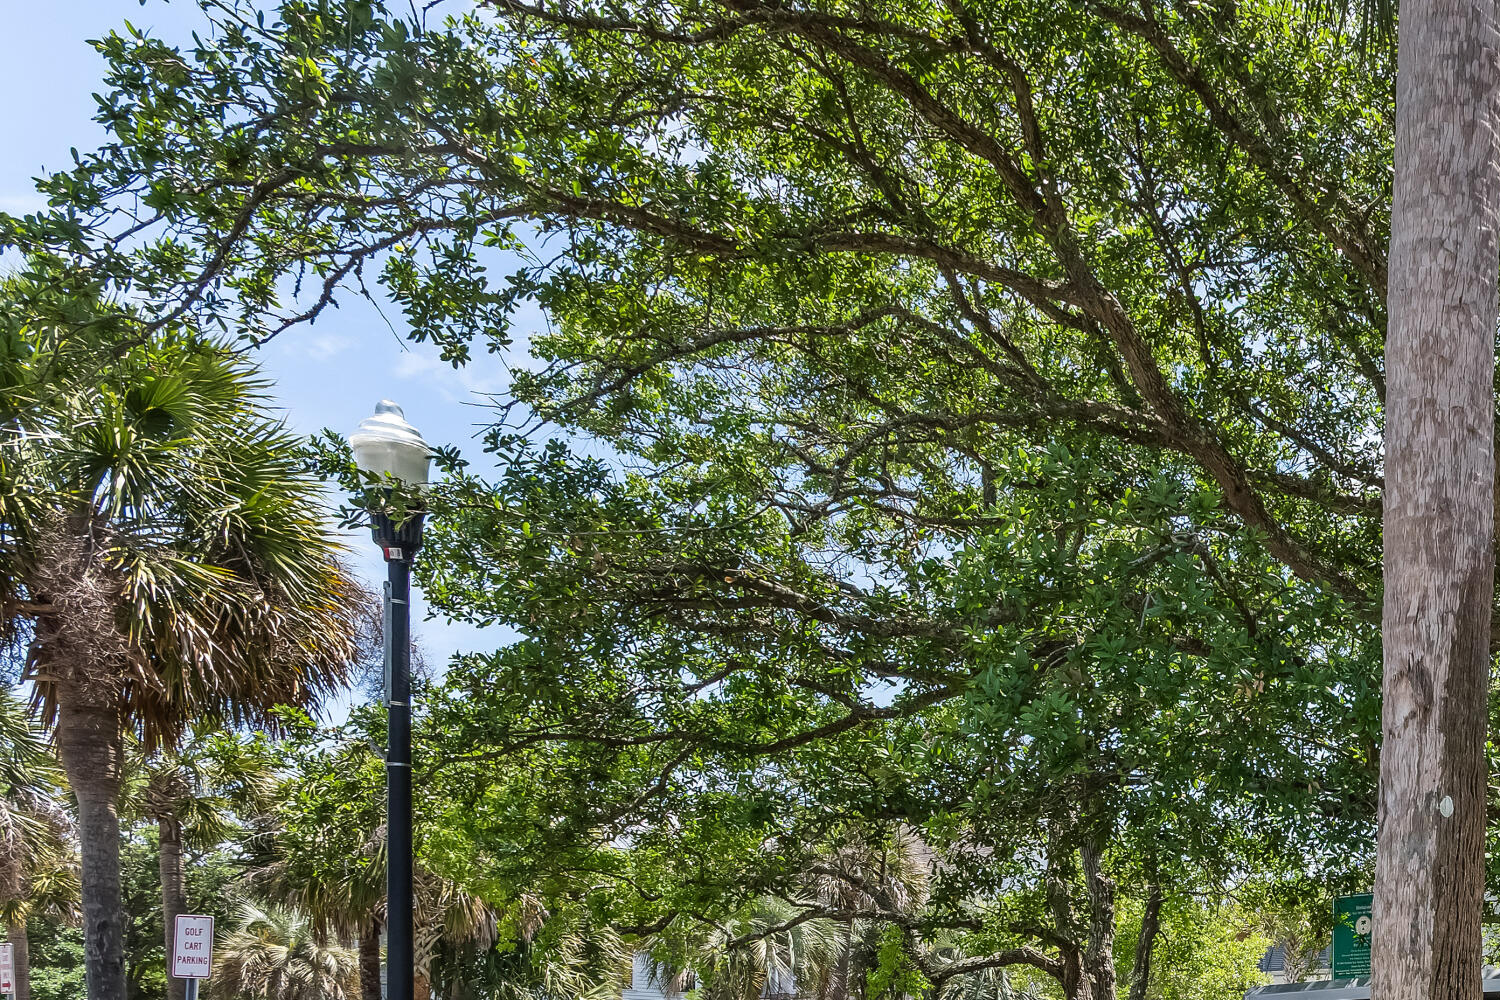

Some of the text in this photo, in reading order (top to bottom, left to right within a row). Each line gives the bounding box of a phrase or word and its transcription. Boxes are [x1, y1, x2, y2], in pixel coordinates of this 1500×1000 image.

[185, 928, 203, 936] GOLF
[184, 942, 202, 950] CART
[177, 955, 208, 965] PARKING
